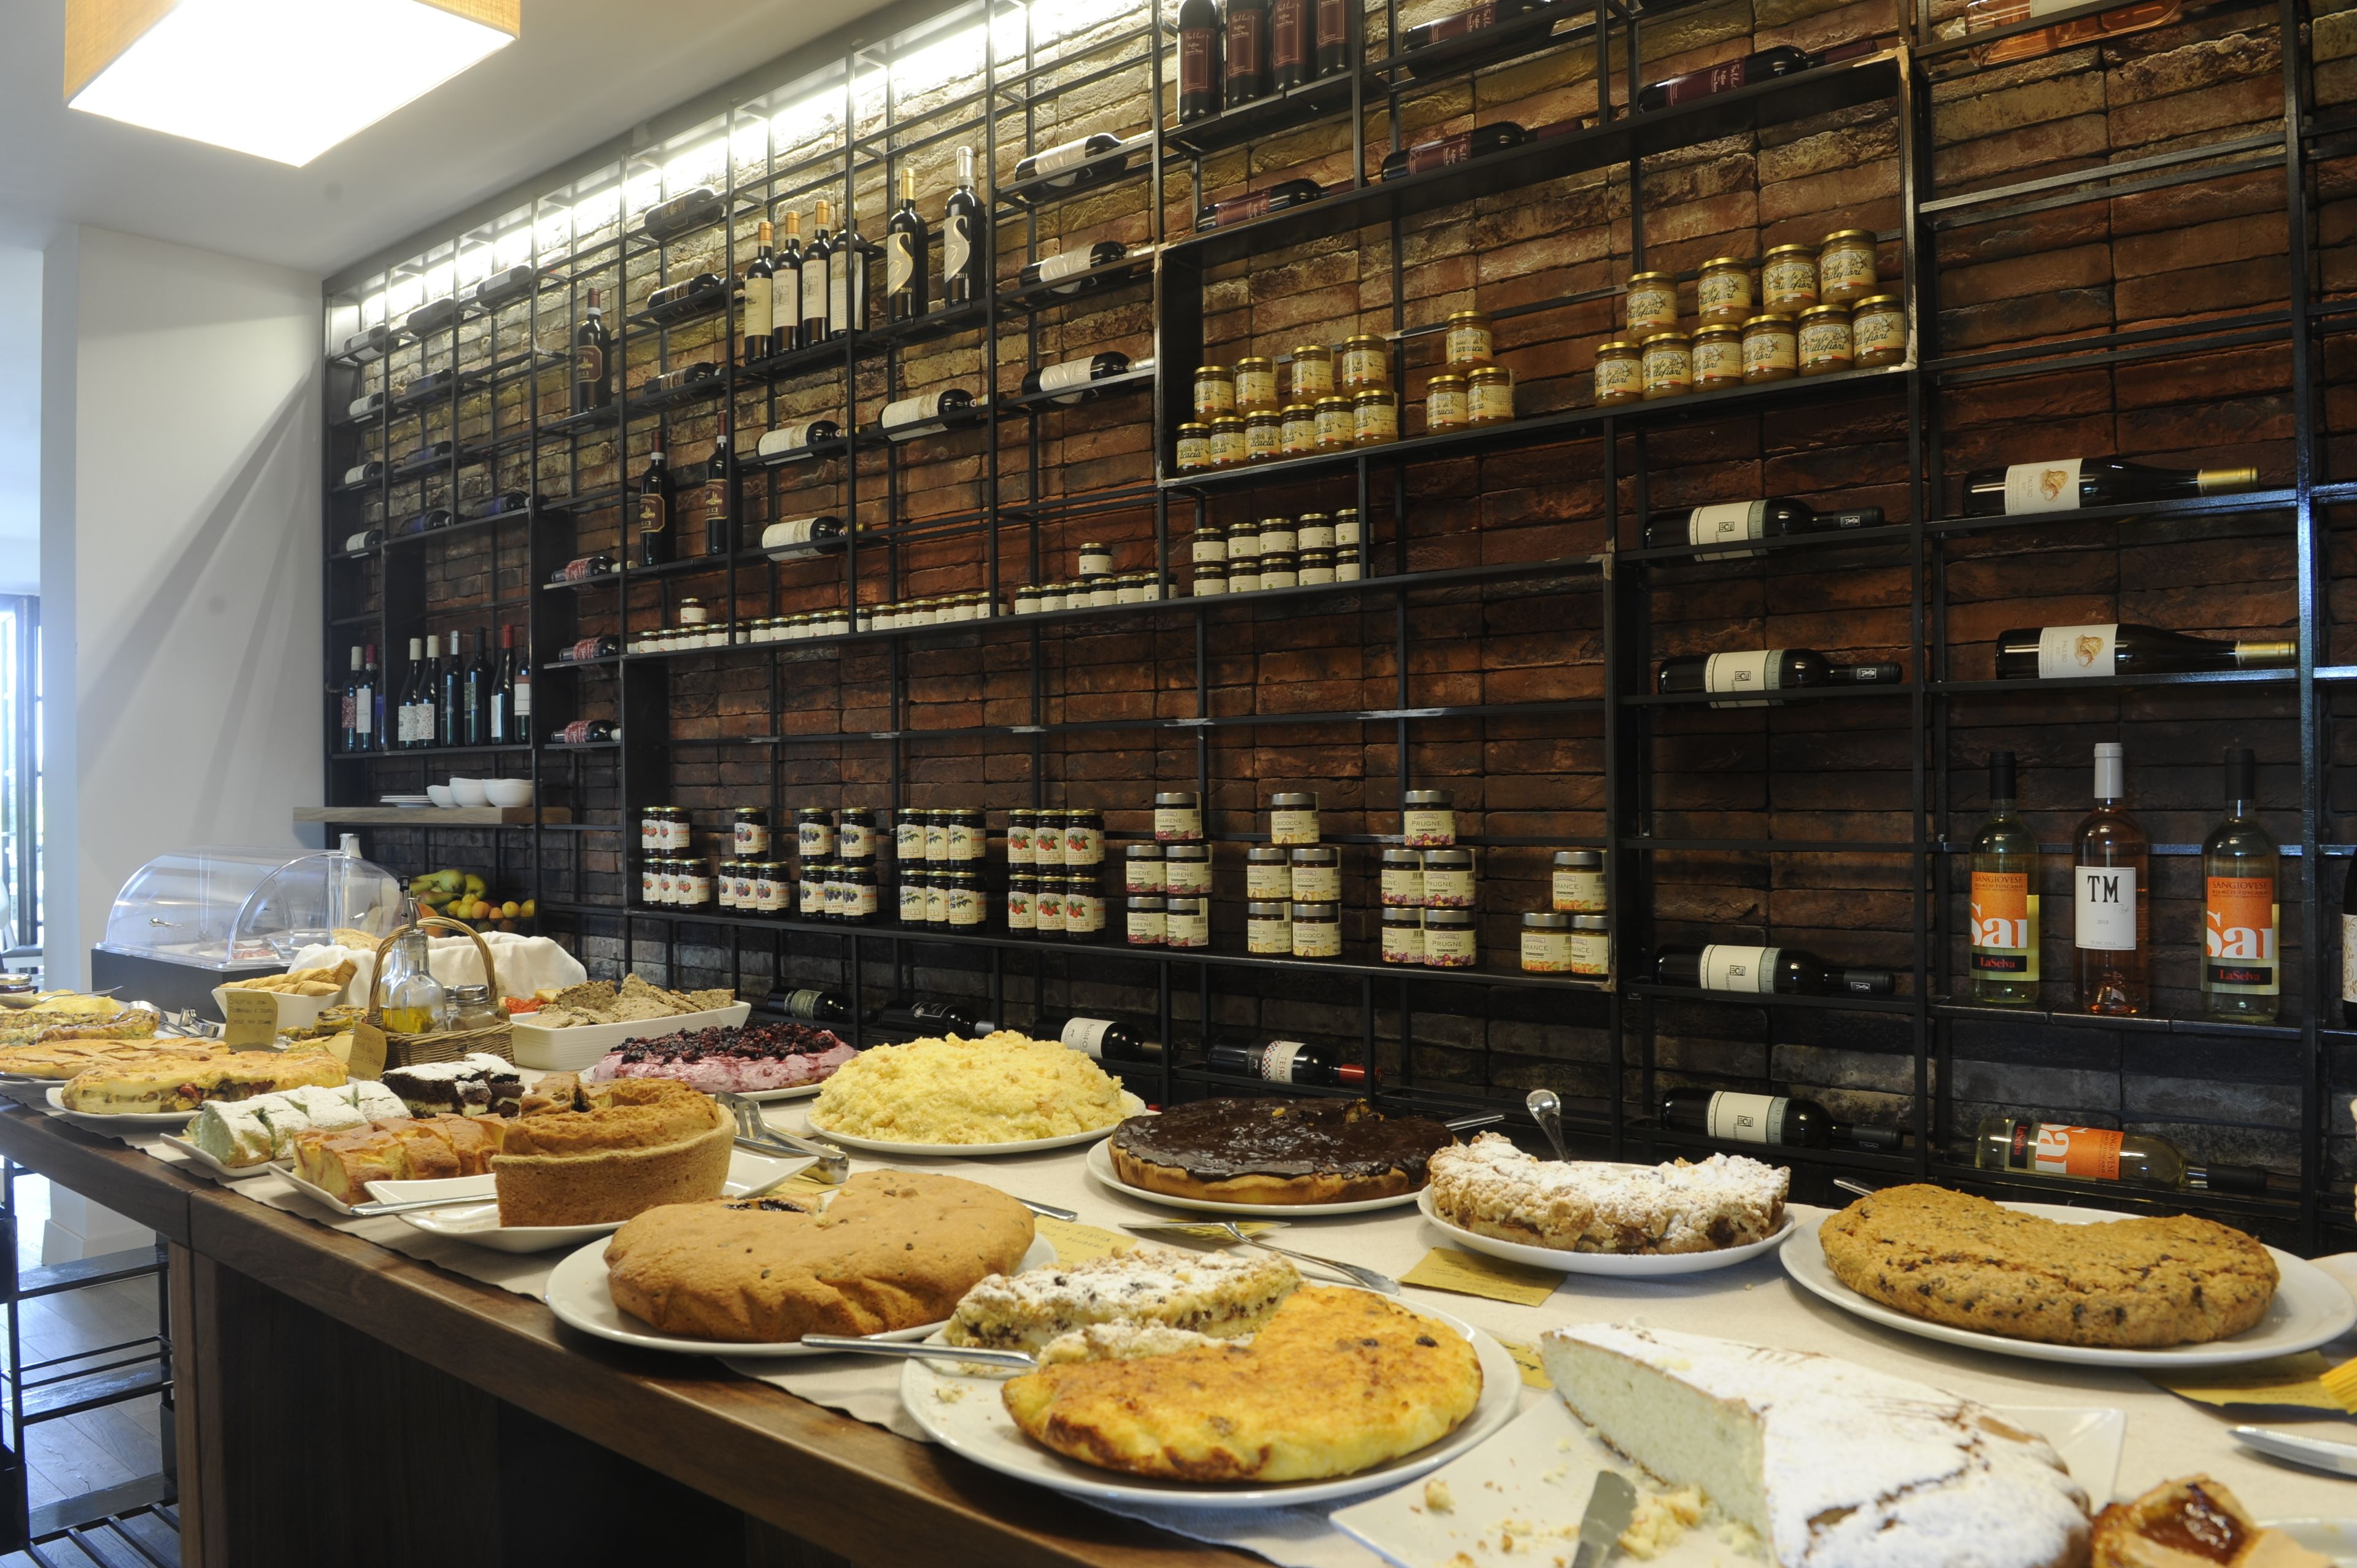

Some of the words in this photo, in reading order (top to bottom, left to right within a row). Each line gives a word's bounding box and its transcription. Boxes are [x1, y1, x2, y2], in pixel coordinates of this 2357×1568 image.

[2087, 875, 2119, 903] TM
[1980, 957, 2015, 968] LaSelva
[2220, 969, 2261, 981] LaSelva
[2013, 1126, 2028, 1156] LaSelva
